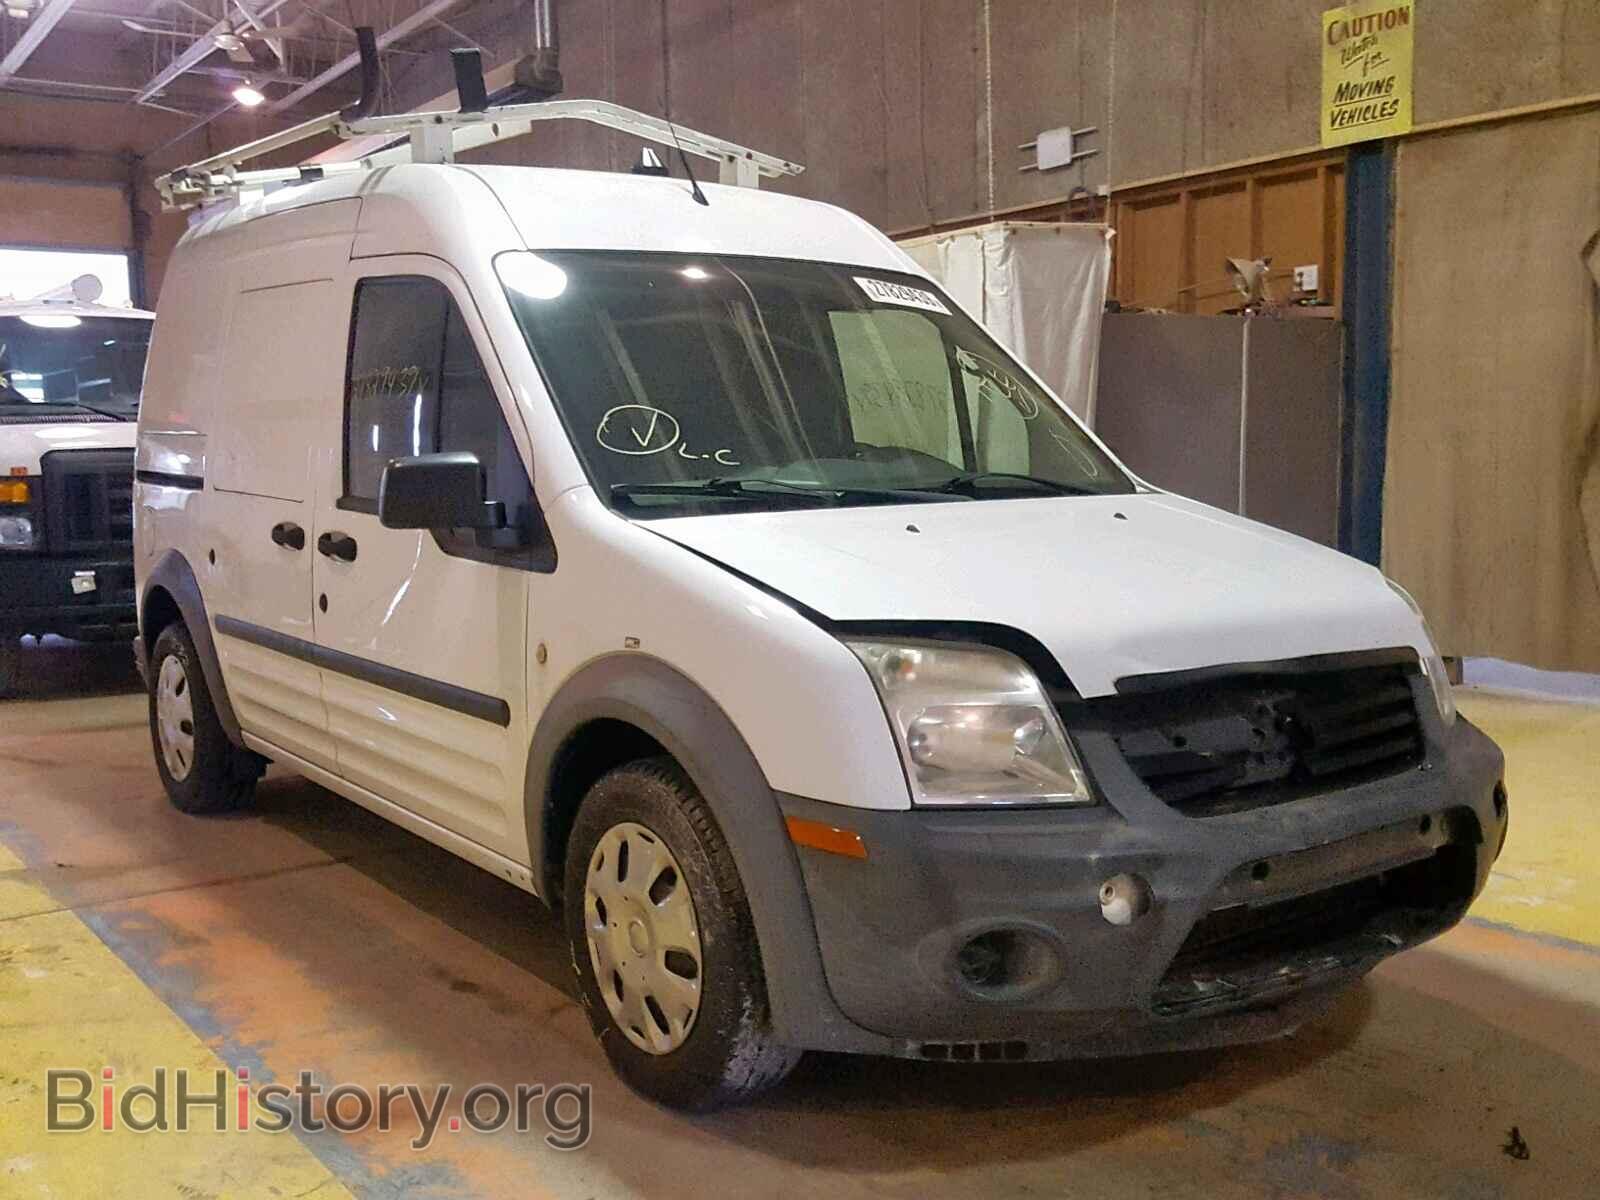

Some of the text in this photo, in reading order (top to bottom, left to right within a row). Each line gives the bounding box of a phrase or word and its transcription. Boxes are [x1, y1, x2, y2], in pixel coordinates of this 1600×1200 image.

[1327, 5, 1410, 46] CAUTION
[1333, 76, 1396, 105] MOVING
[1330, 98, 1400, 128] VEHICLES
